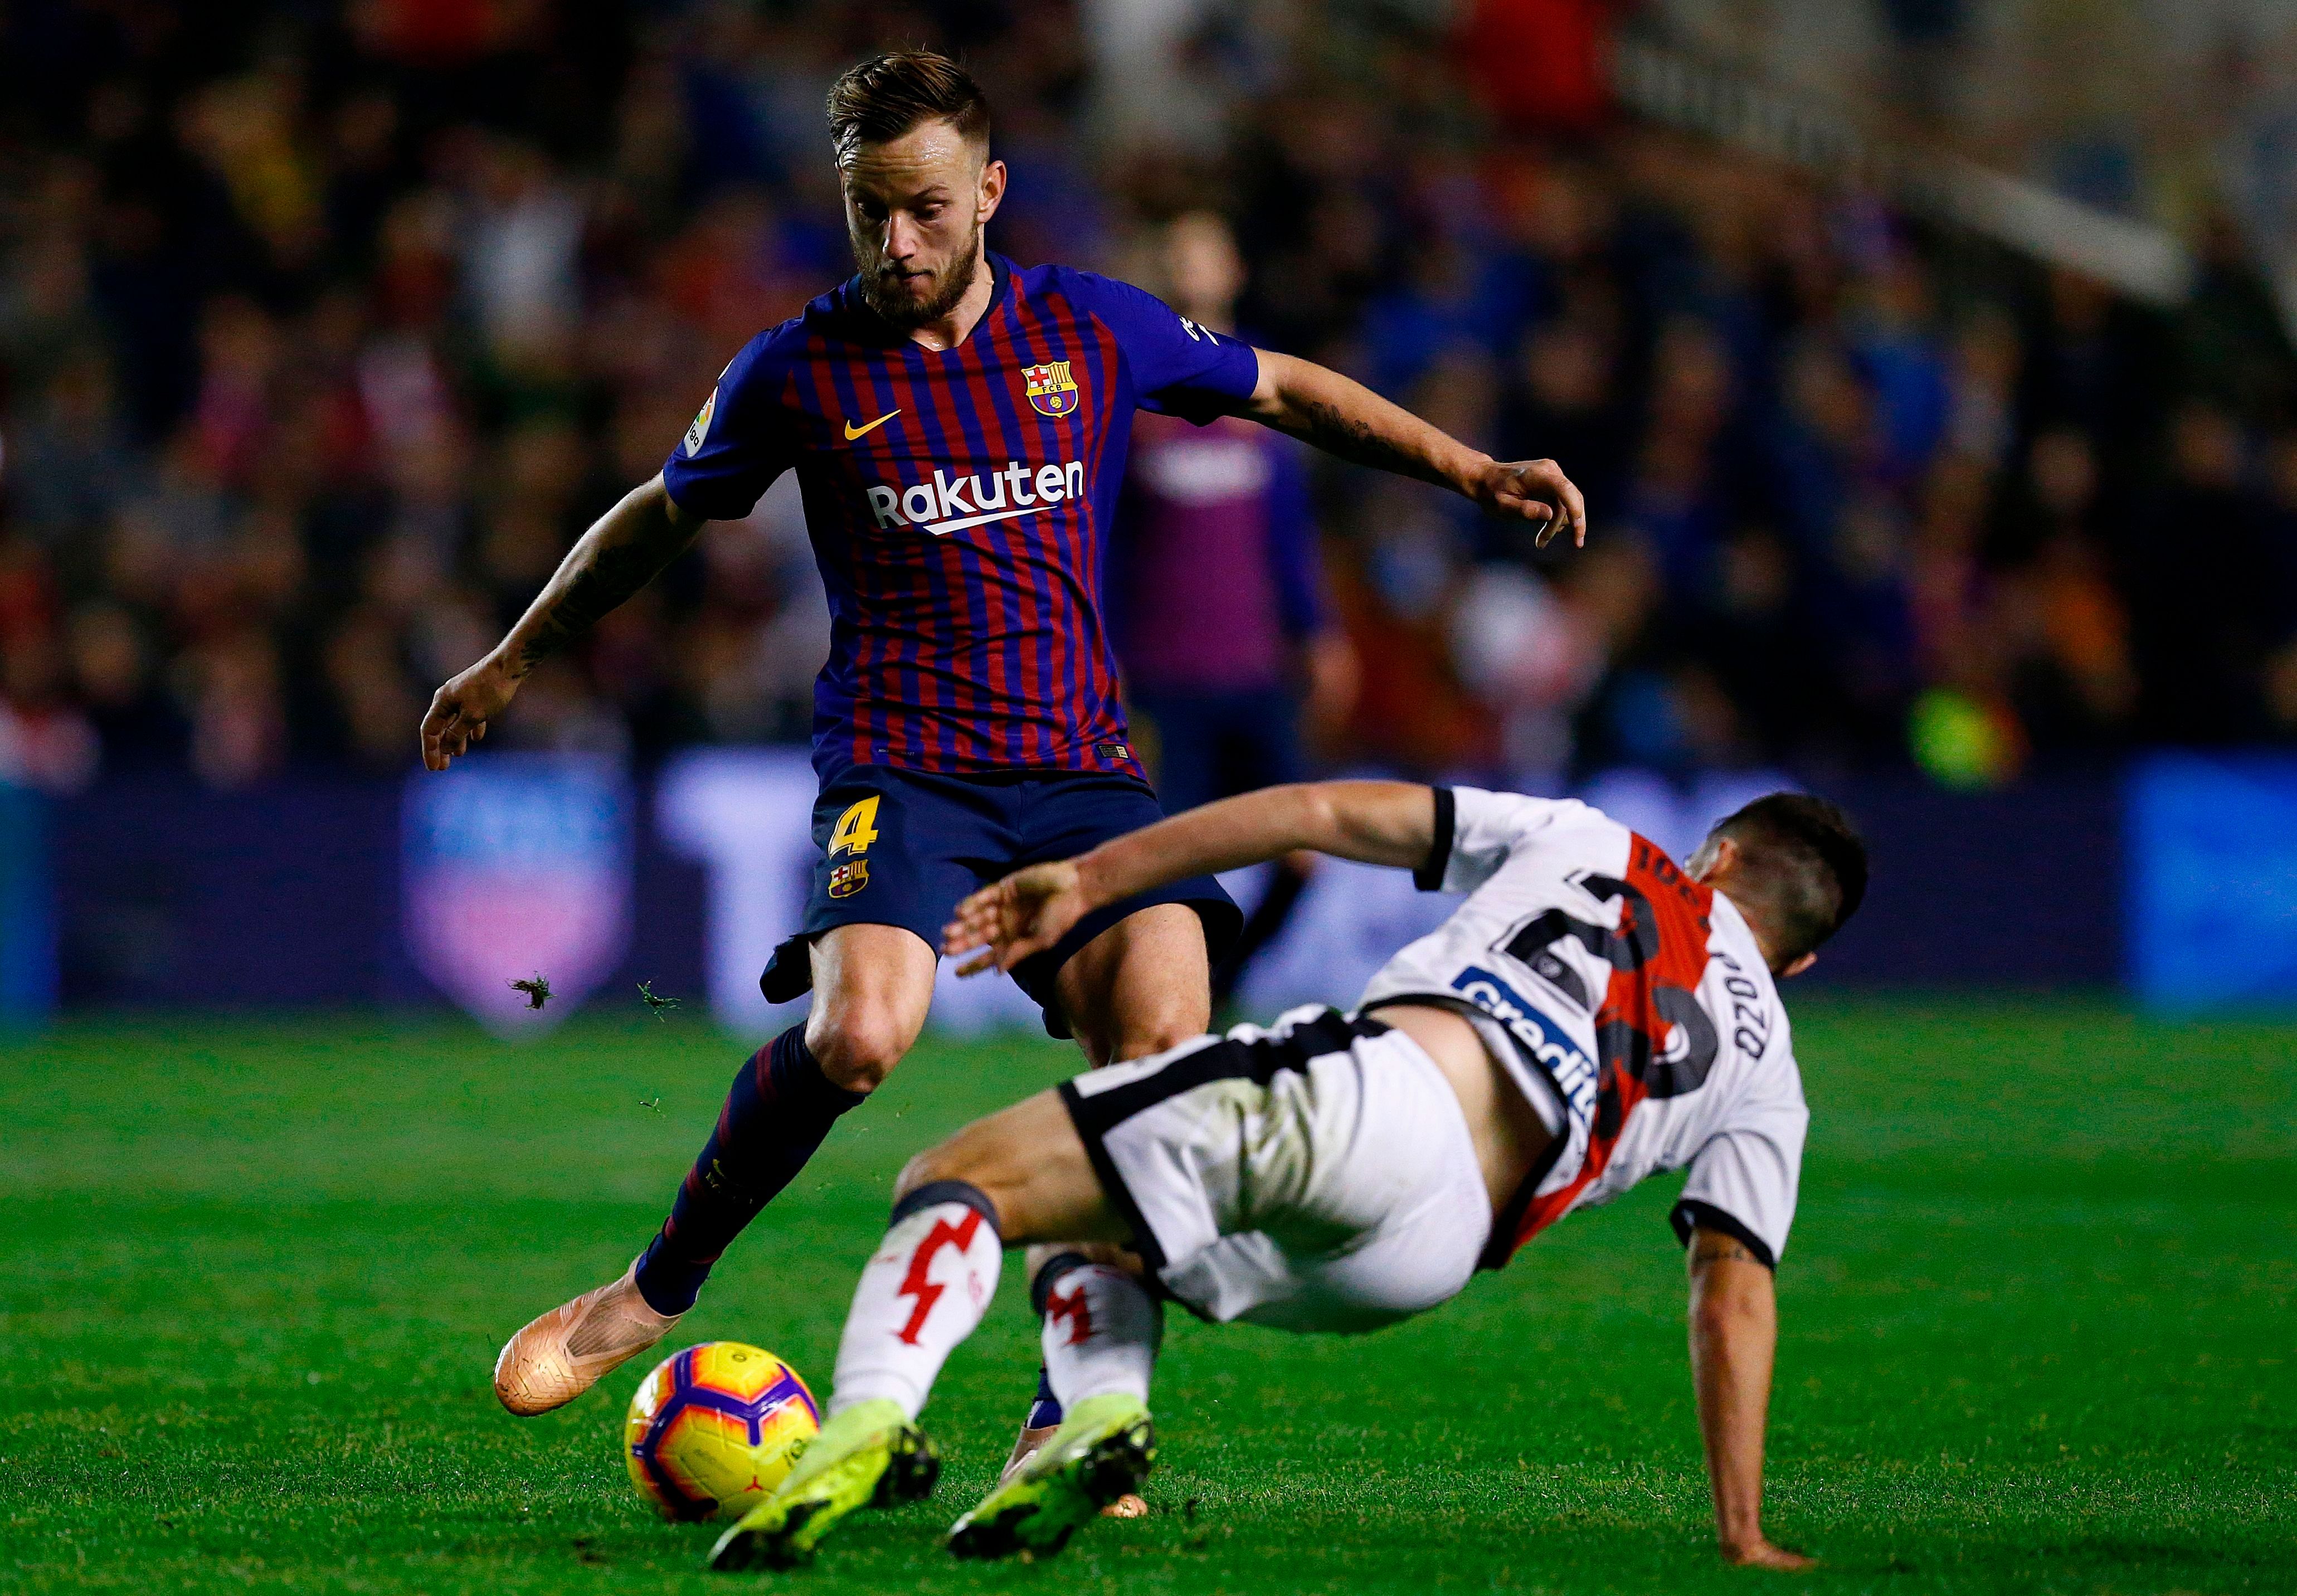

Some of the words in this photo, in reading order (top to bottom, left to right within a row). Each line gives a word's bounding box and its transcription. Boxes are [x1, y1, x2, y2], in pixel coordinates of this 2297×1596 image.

[1042, 385, 1062, 393] FCB
[867, 460, 1084, 529] Rakuten
[828, 795, 880, 860] 4
